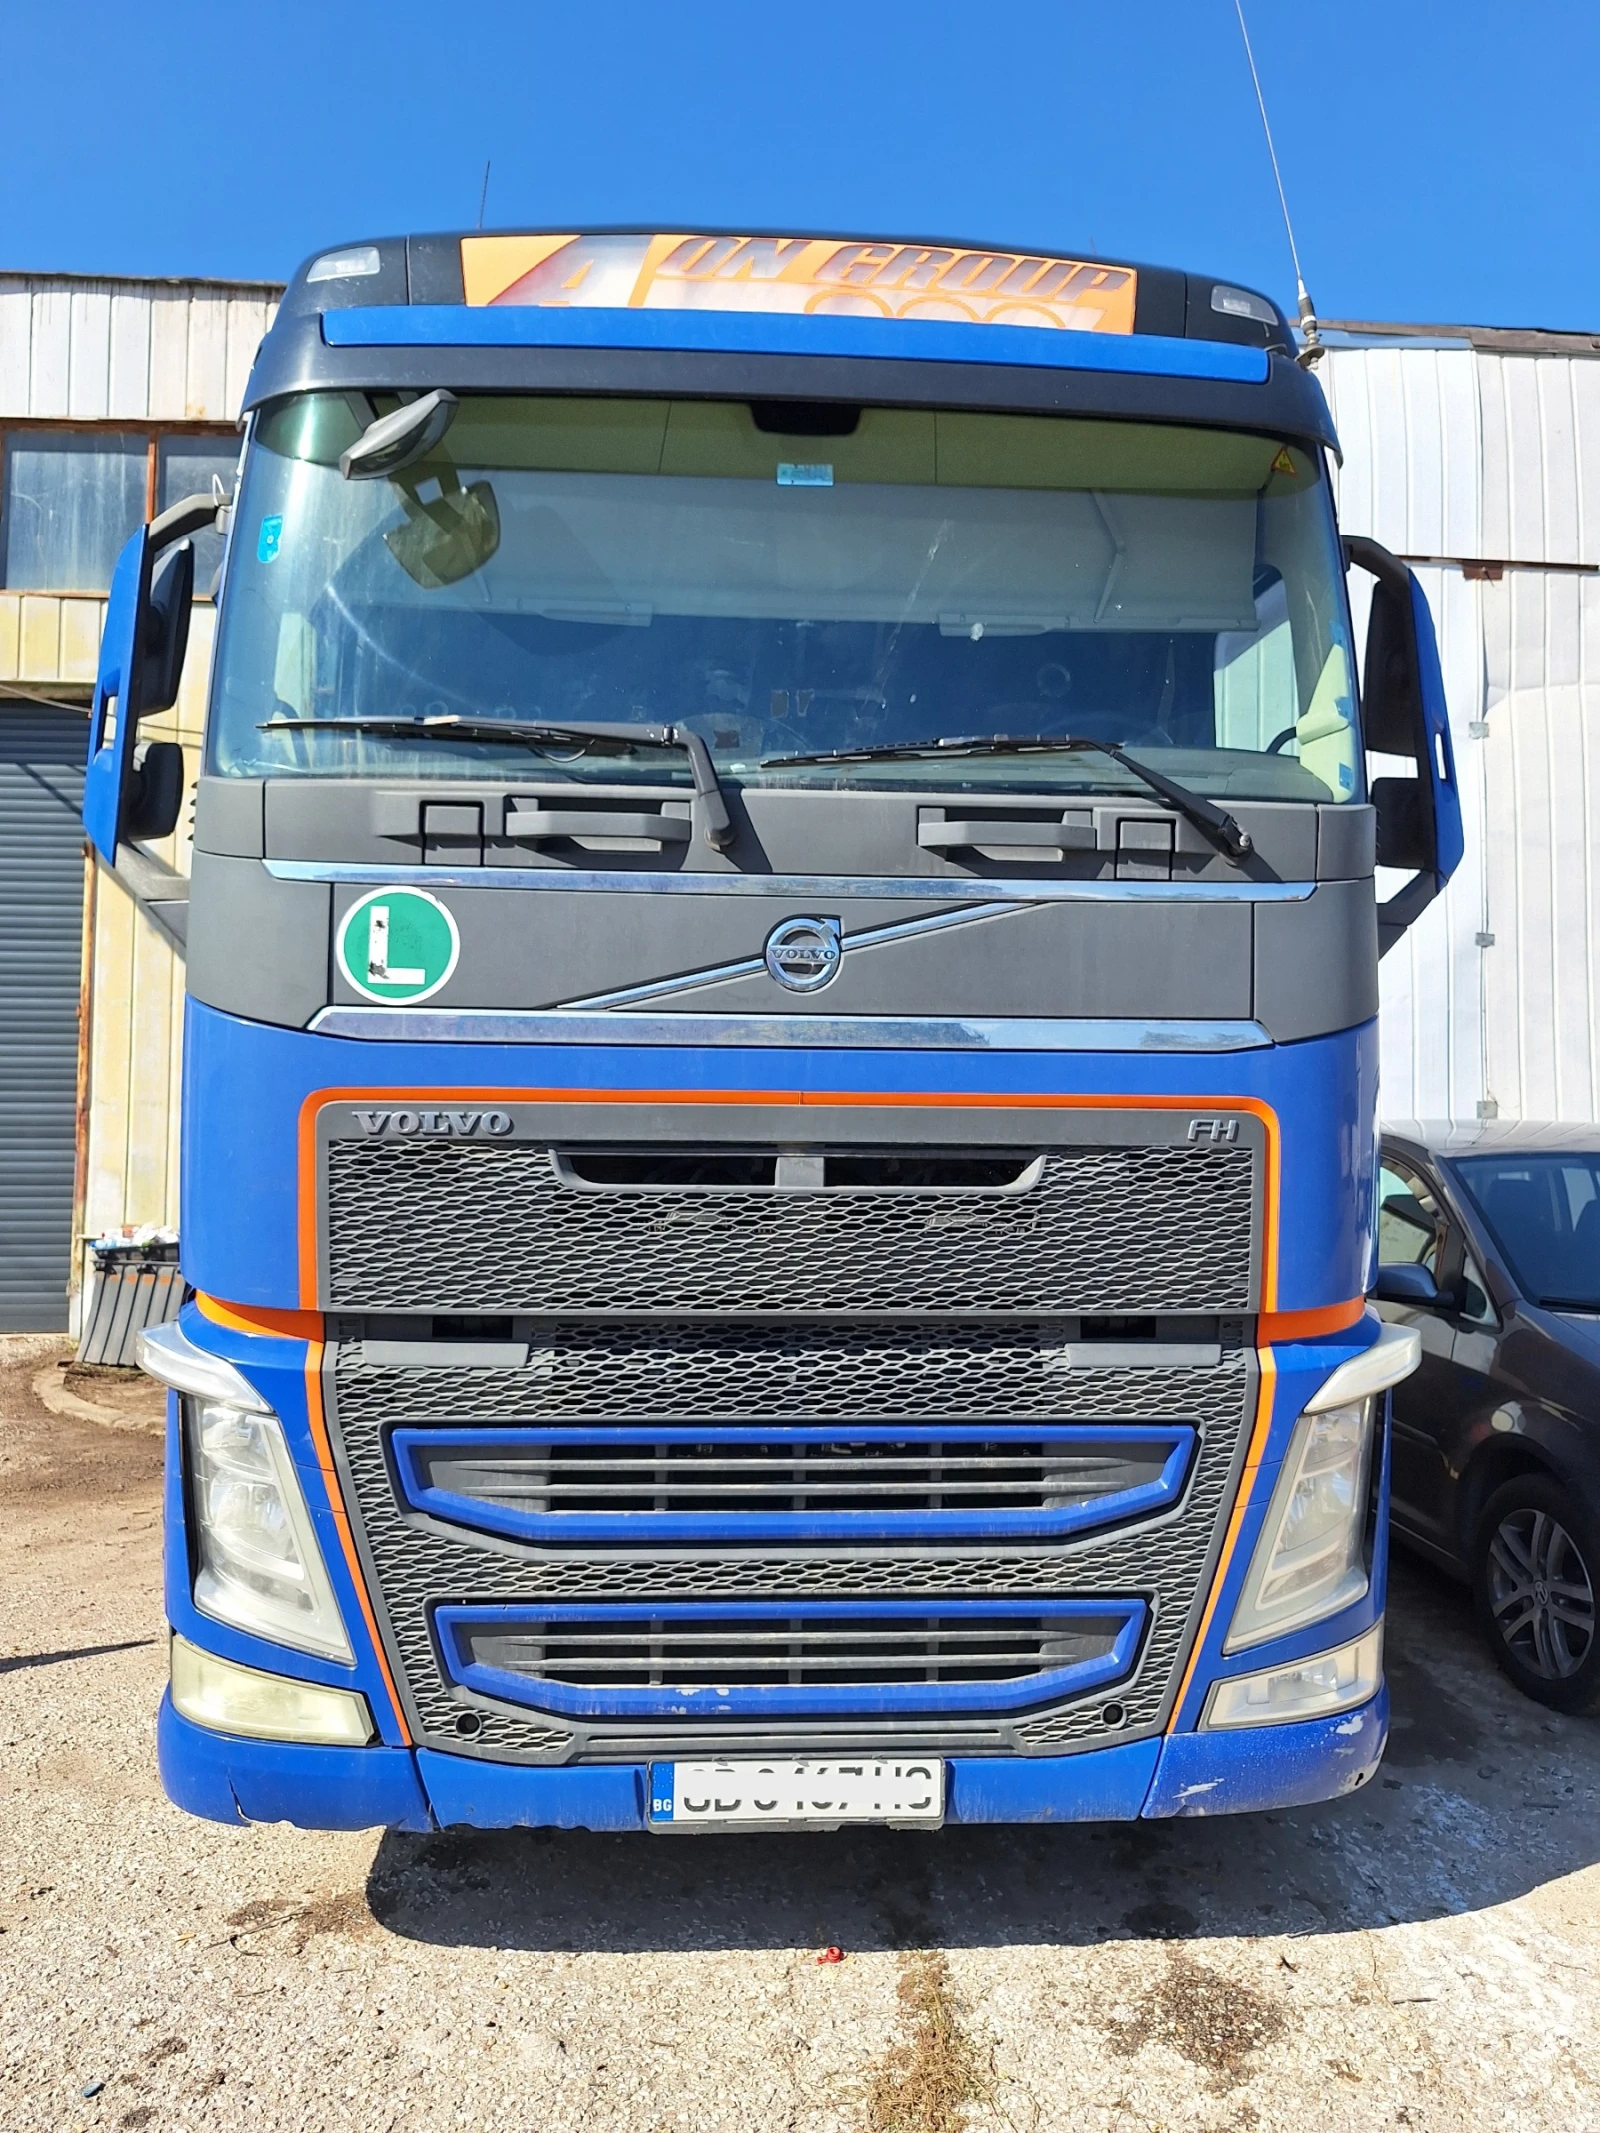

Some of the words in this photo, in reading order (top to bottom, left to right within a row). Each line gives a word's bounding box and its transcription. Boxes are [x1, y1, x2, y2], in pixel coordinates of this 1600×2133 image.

[814, 244, 1132, 301] GROUP
[367, 905, 426, 985] L
[769, 949, 836, 960] VOLVO
[352, 1111, 513, 1136] VOLVO
[1187, 1119, 1238, 1141] FH
[652, 1798, 673, 1812] BG
